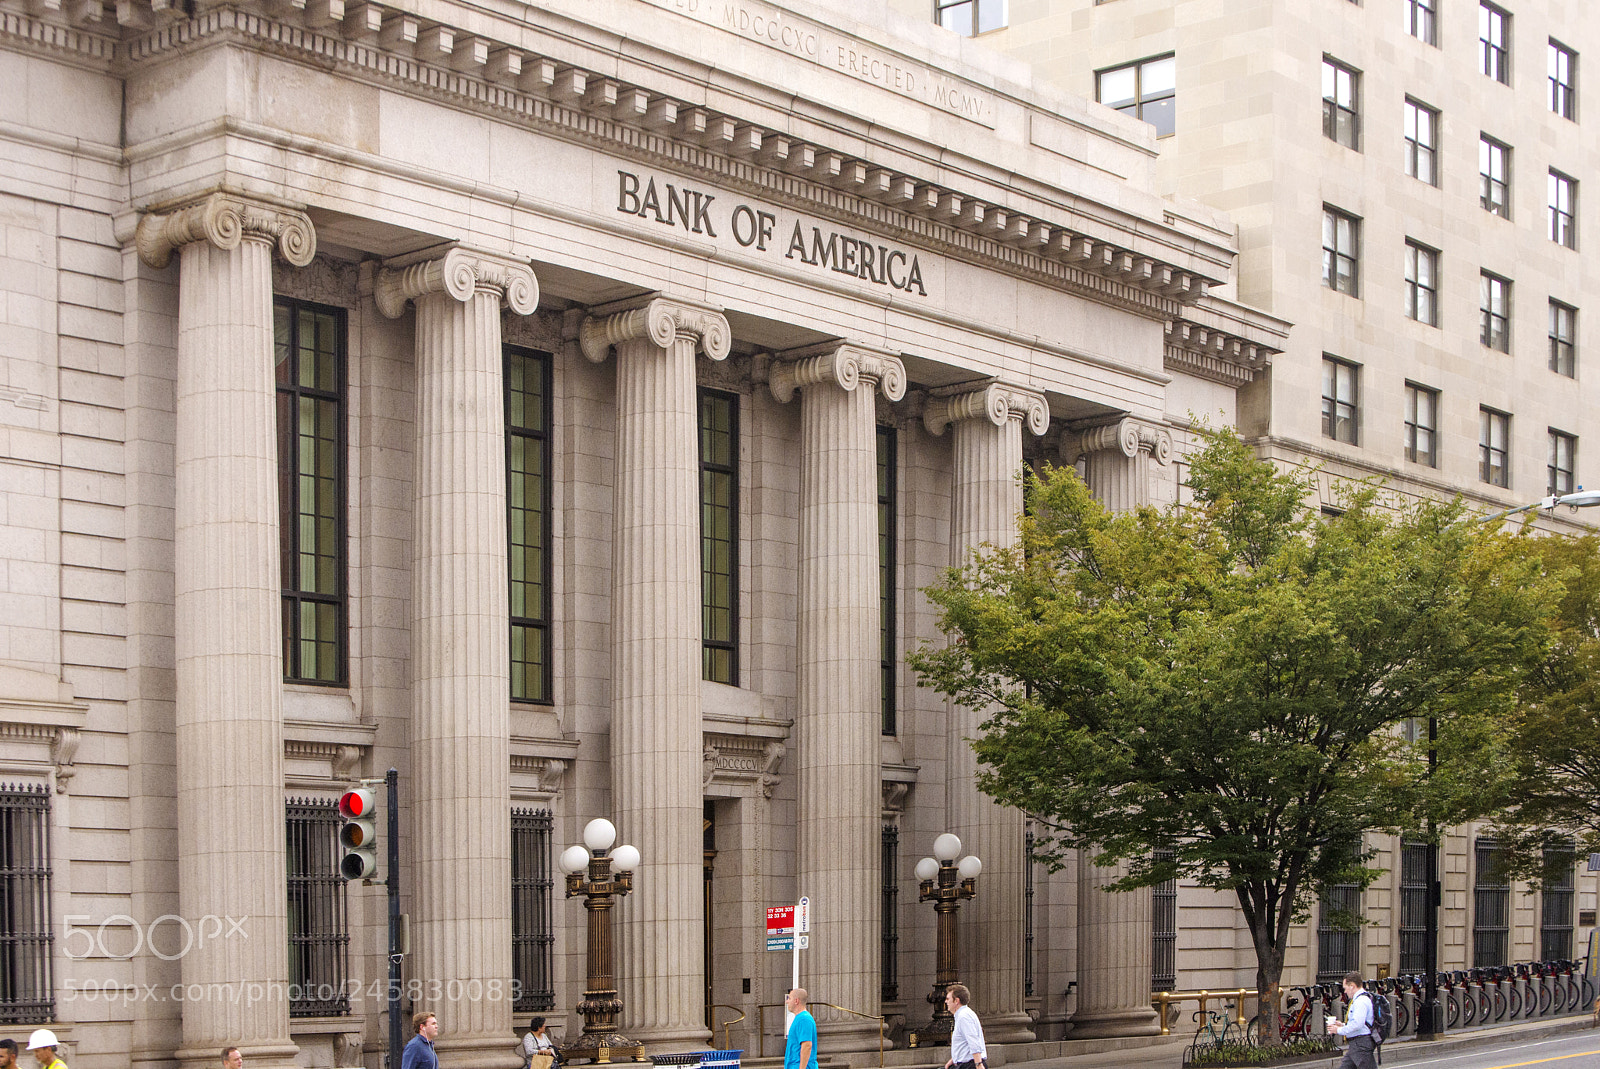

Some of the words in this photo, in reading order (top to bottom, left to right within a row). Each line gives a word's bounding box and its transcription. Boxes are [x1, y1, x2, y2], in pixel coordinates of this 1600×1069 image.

[838, 46, 915, 93] ERECTED
[934, 86, 984, 116] MCMV
[616, 169, 718, 239] BANK
[731, 204, 776, 251] OF
[785, 218, 928, 297] AMERICA
